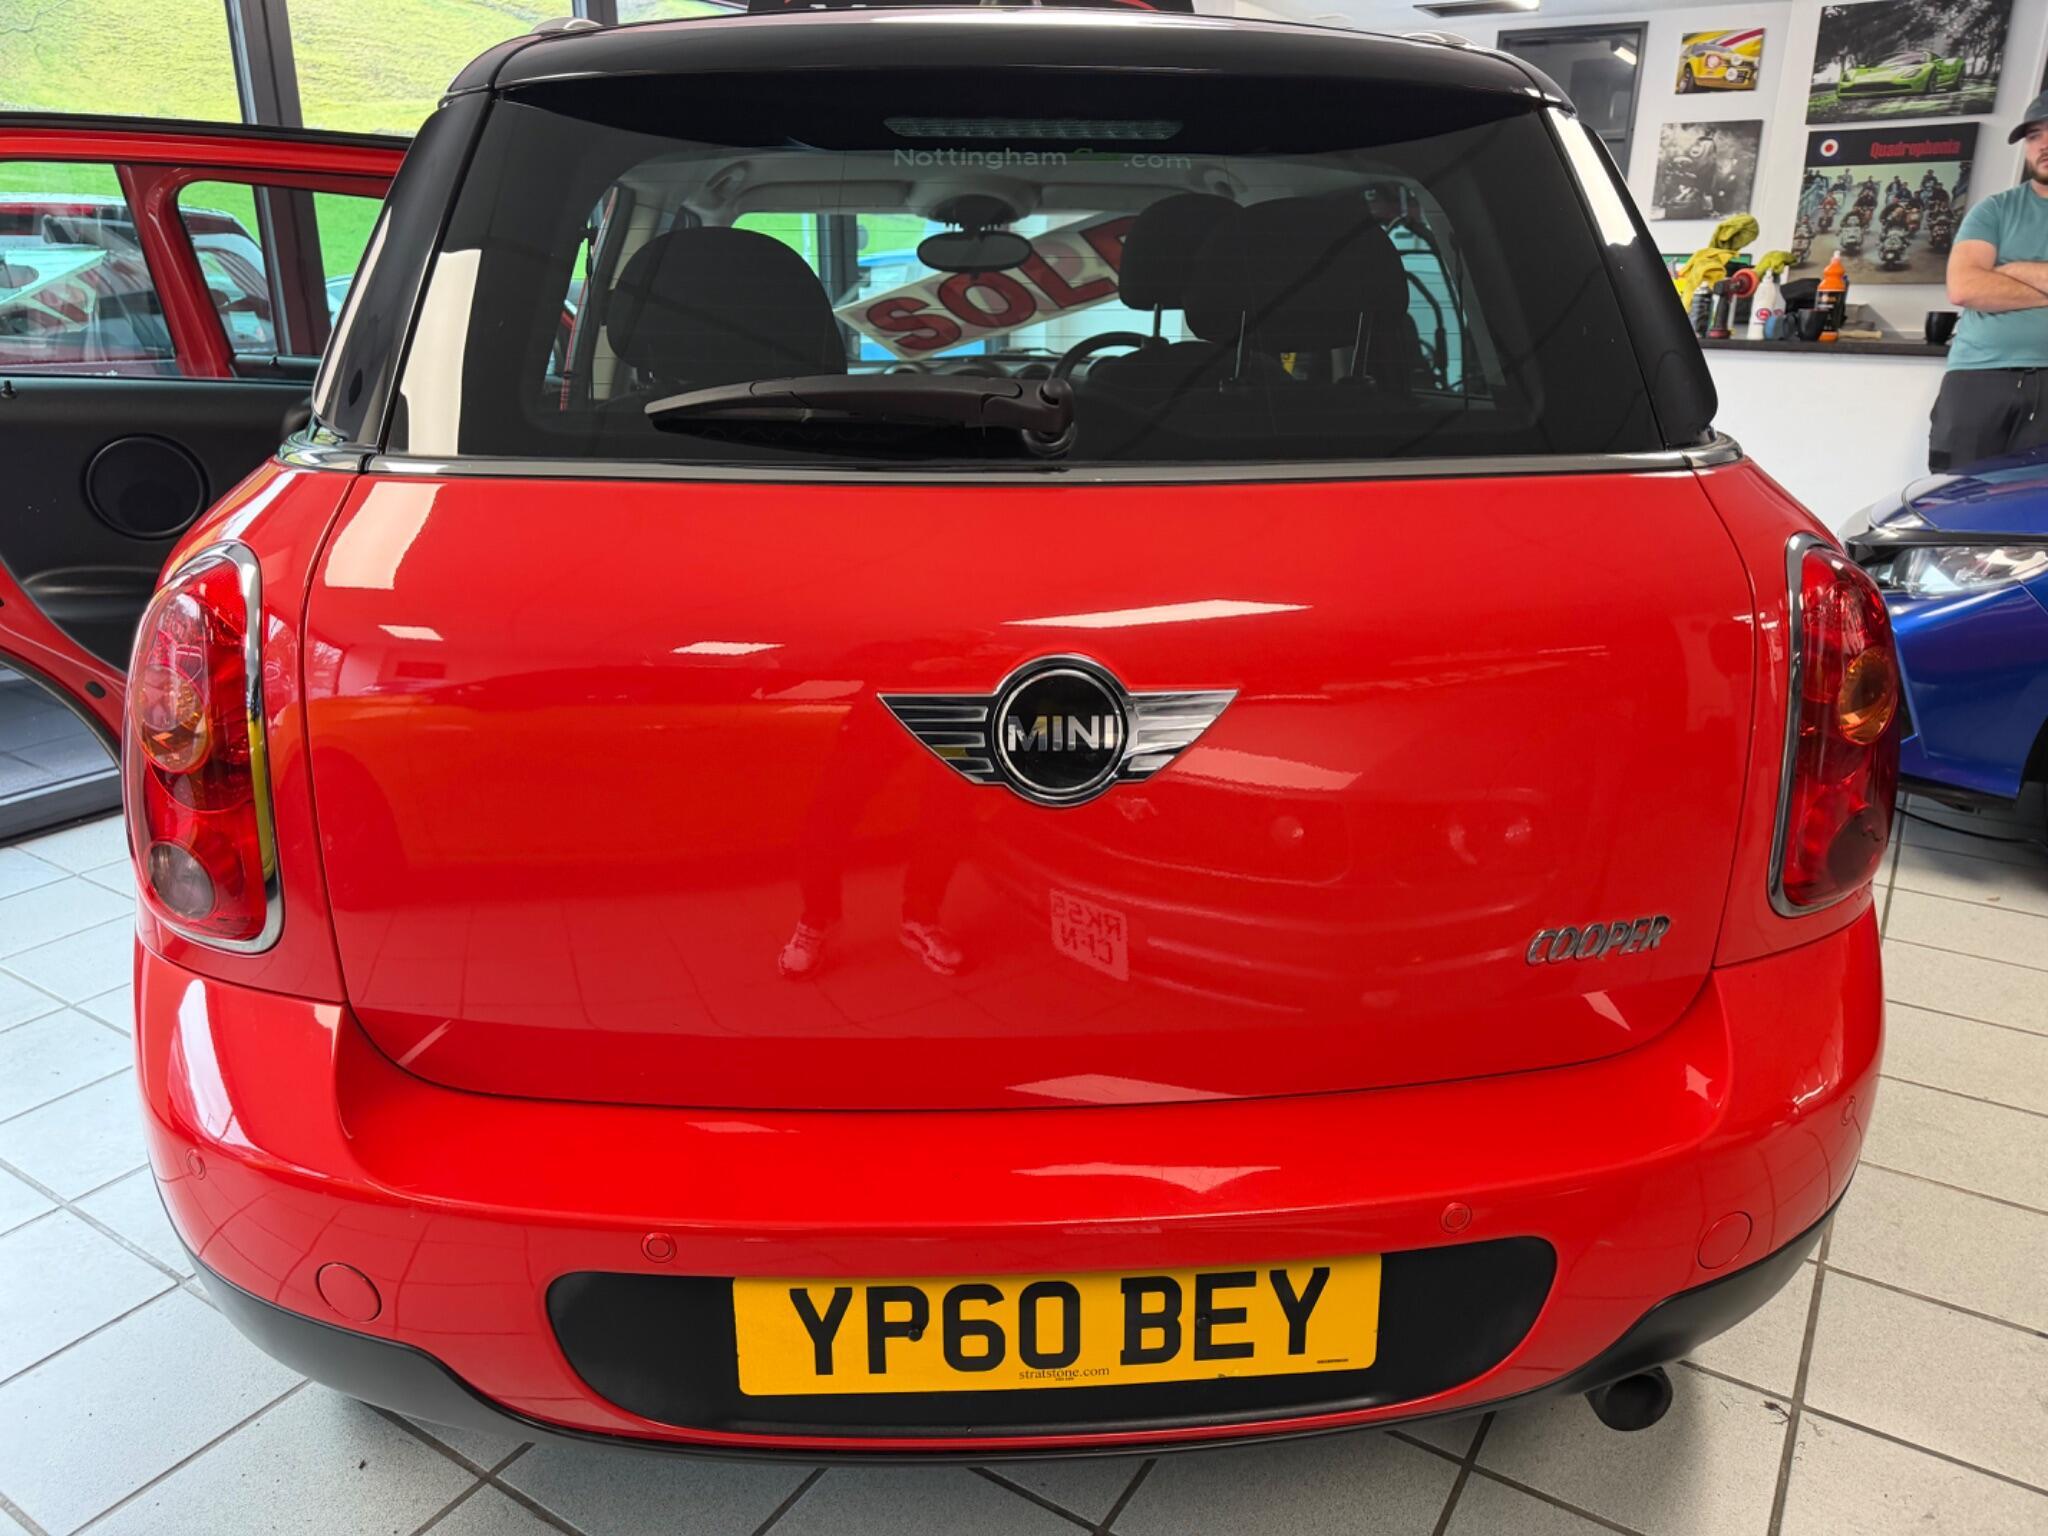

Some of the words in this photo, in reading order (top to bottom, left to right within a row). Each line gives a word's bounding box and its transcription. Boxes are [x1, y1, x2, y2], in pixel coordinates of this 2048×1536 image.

[1007, 715, 1118, 751] MINI
[1527, 916, 1671, 965] COOPER
[790, 1280, 1080, 1376] YP60
[1120, 1267, 1331, 1366] BEY
[1018, 1367, 1110, 1380] stratstone.com
